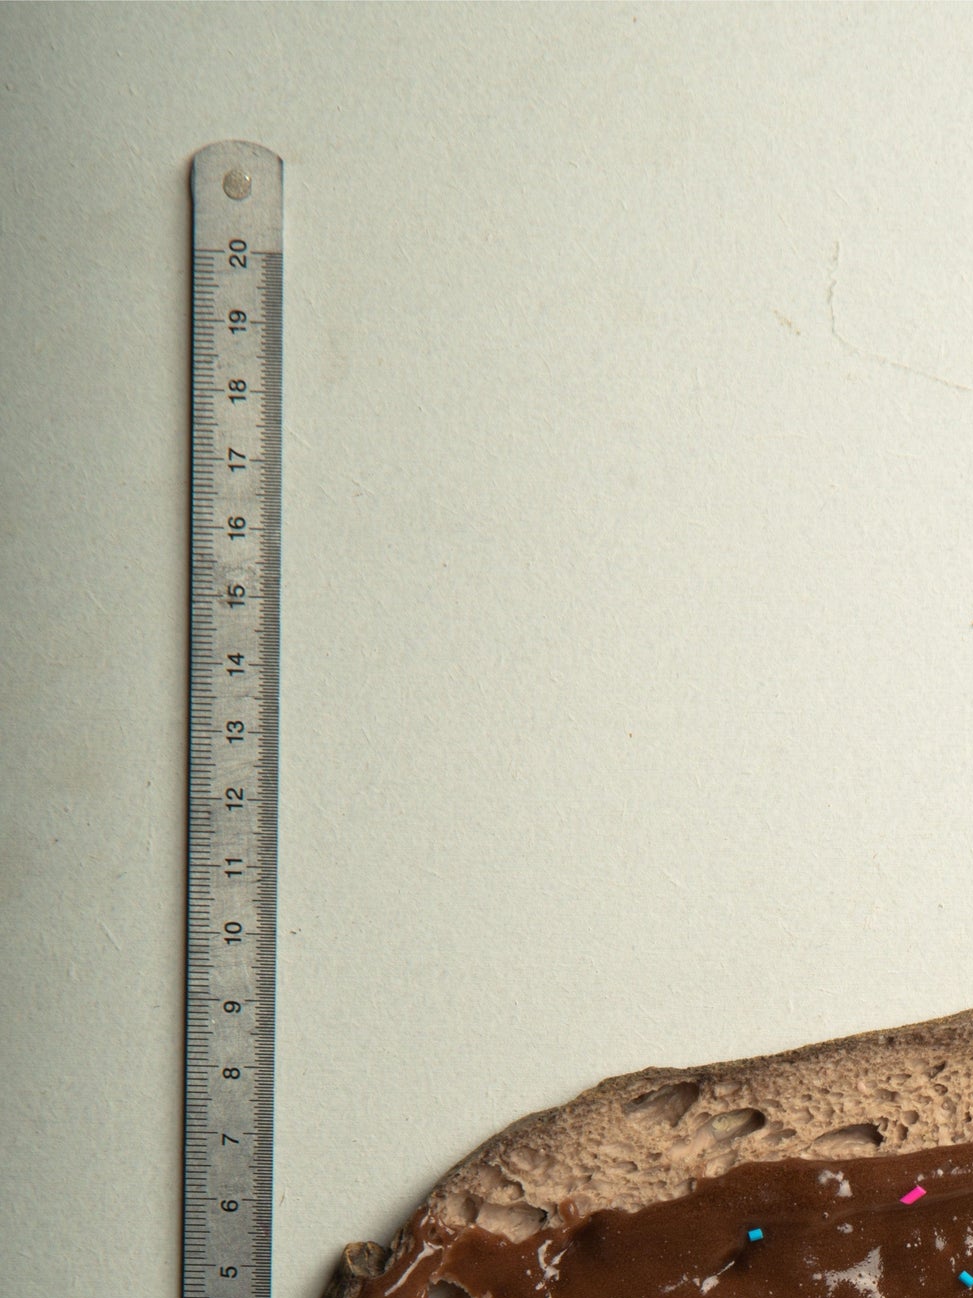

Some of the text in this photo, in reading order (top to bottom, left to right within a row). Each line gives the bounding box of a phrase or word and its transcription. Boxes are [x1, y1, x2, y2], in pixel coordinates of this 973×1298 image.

[228, 239, 248, 269] 20
[228, 309, 247, 335] 19
[228, 379, 247, 404] 18
[227, 447, 246, 473] 17
[227, 516, 246, 541] 16
[226, 583, 246, 609] 15
[226, 652, 245, 677] 14
[225, 720, 245, 744] 13
[225, 787, 244, 811] 12
[224, 858, 243, 879] 11
[223, 921, 243, 945] 10
[223, 1000, 242, 1014] 9
[222, 1067, 241, 1080] 8
[221, 1133, 240, 1146] 7
[220, 1199, 239, 1213] 6
[219, 1266, 238, 1279] 5
